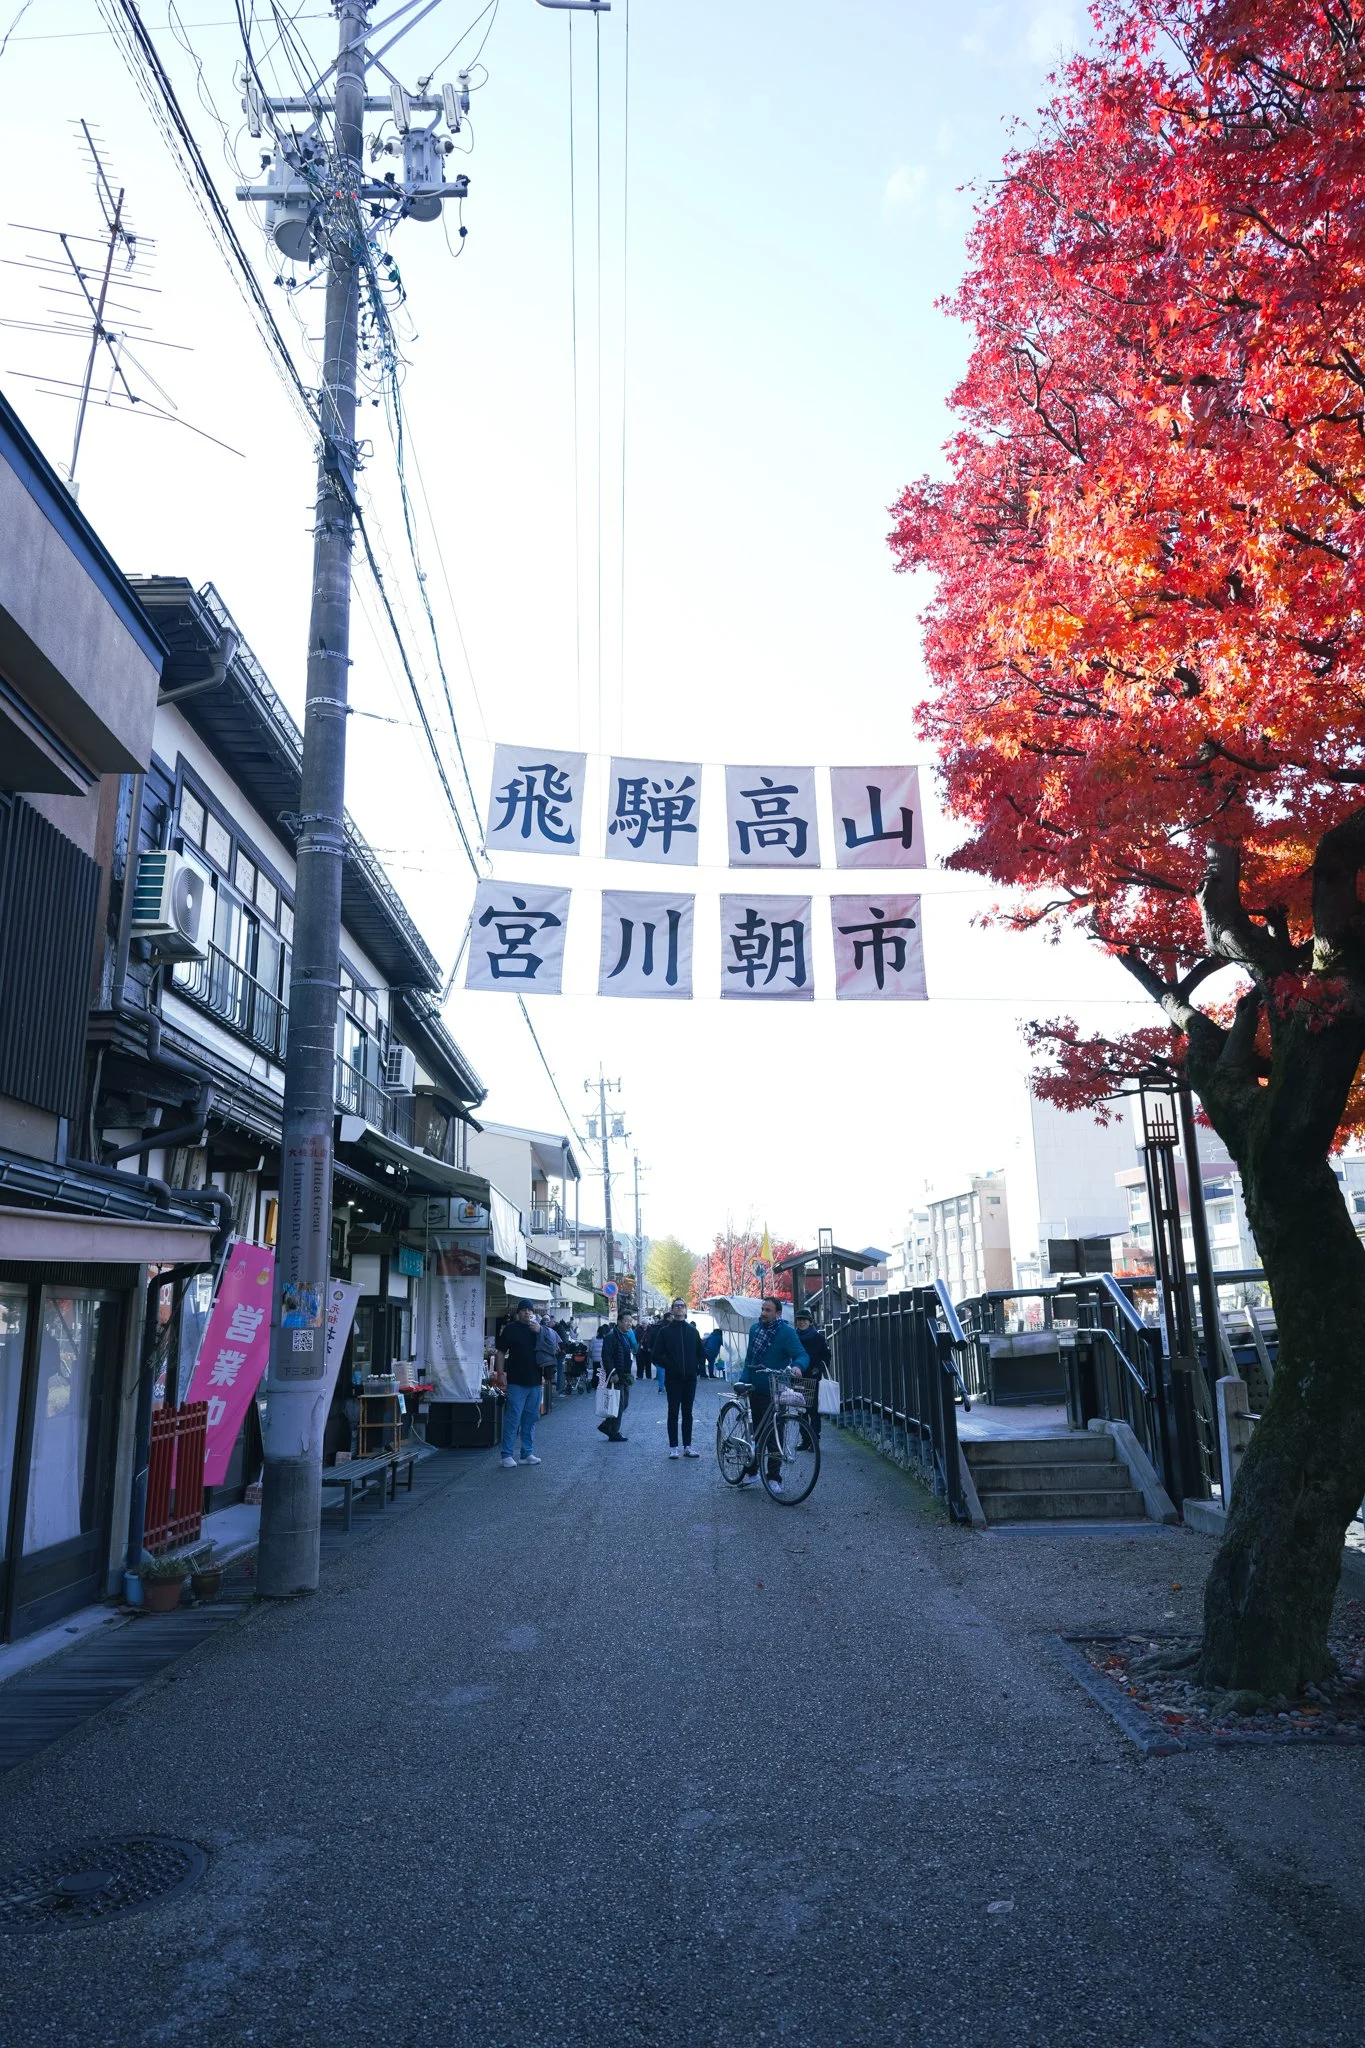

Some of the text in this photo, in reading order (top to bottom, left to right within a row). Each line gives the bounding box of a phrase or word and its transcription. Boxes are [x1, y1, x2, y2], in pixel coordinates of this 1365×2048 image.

[492, 762, 914, 859] 飛騨高山
[478, 895, 917, 990] 宮川朝市
[290, 1162, 305, 1282] Limestone Cave
[311, 1161, 324, 1236] Hida Great
[207, 1303, 264, 1431] 営業中
[283, 1366, 318, 1377] 下三之町
